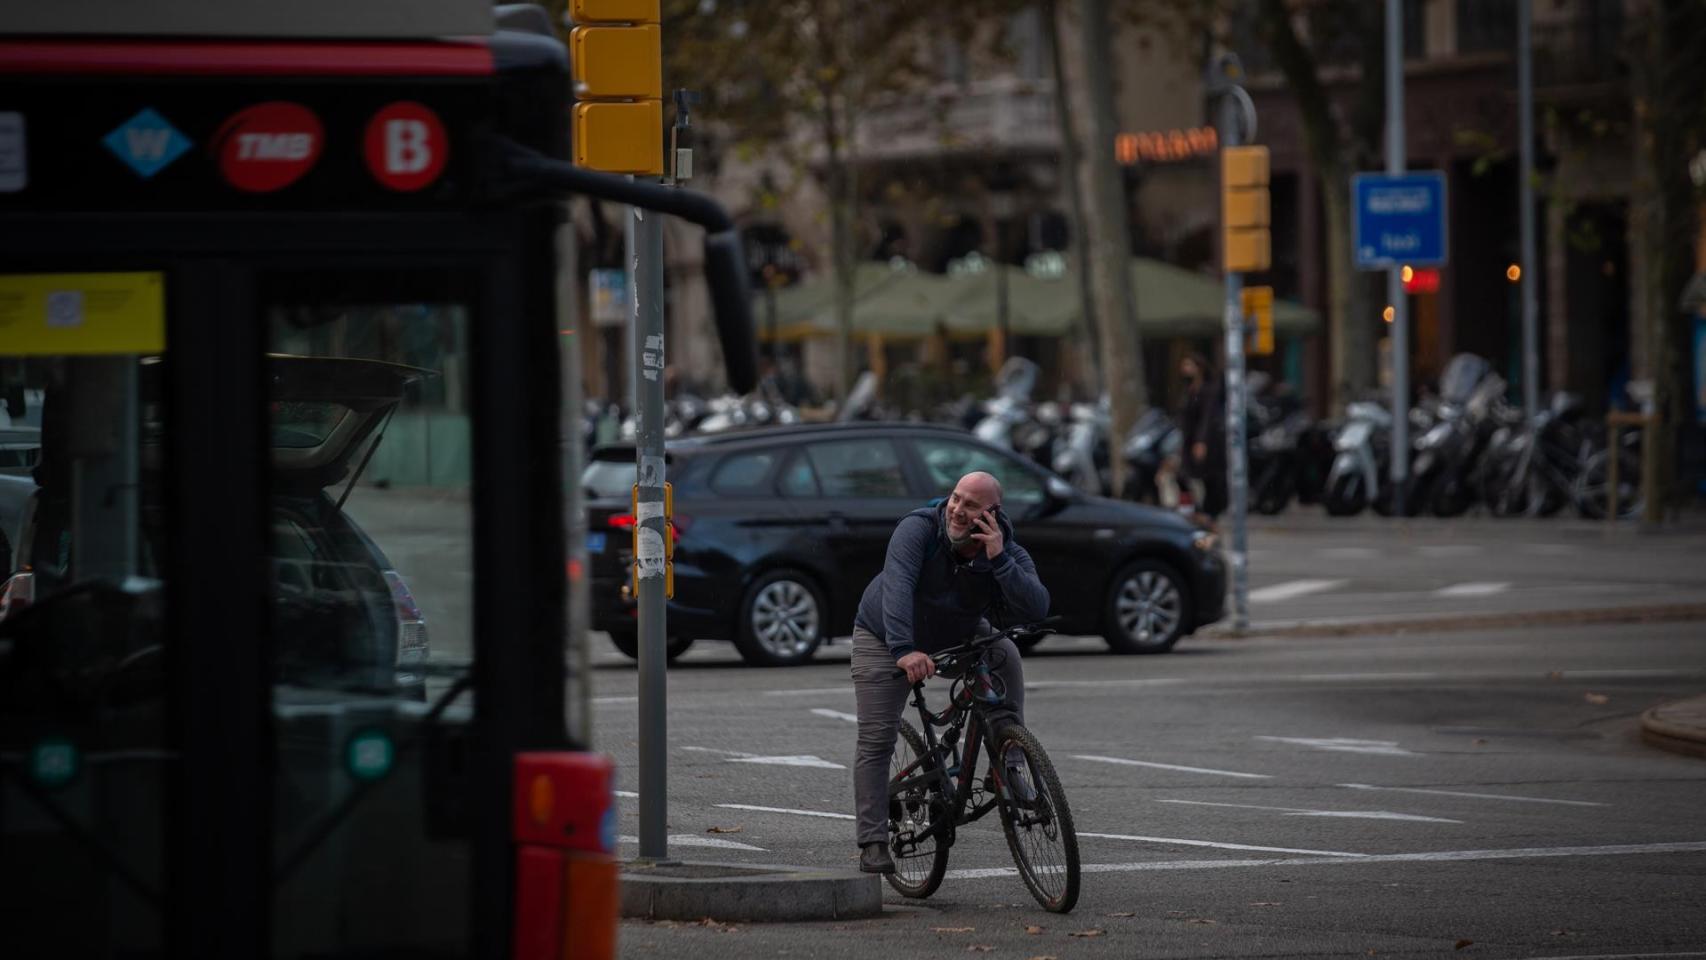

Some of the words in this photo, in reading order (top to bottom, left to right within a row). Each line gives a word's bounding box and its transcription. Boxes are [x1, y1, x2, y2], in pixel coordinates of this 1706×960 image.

[125, 127, 173, 161] W
[235, 131, 314, 161] TMB
[383, 117, 432, 175] B
